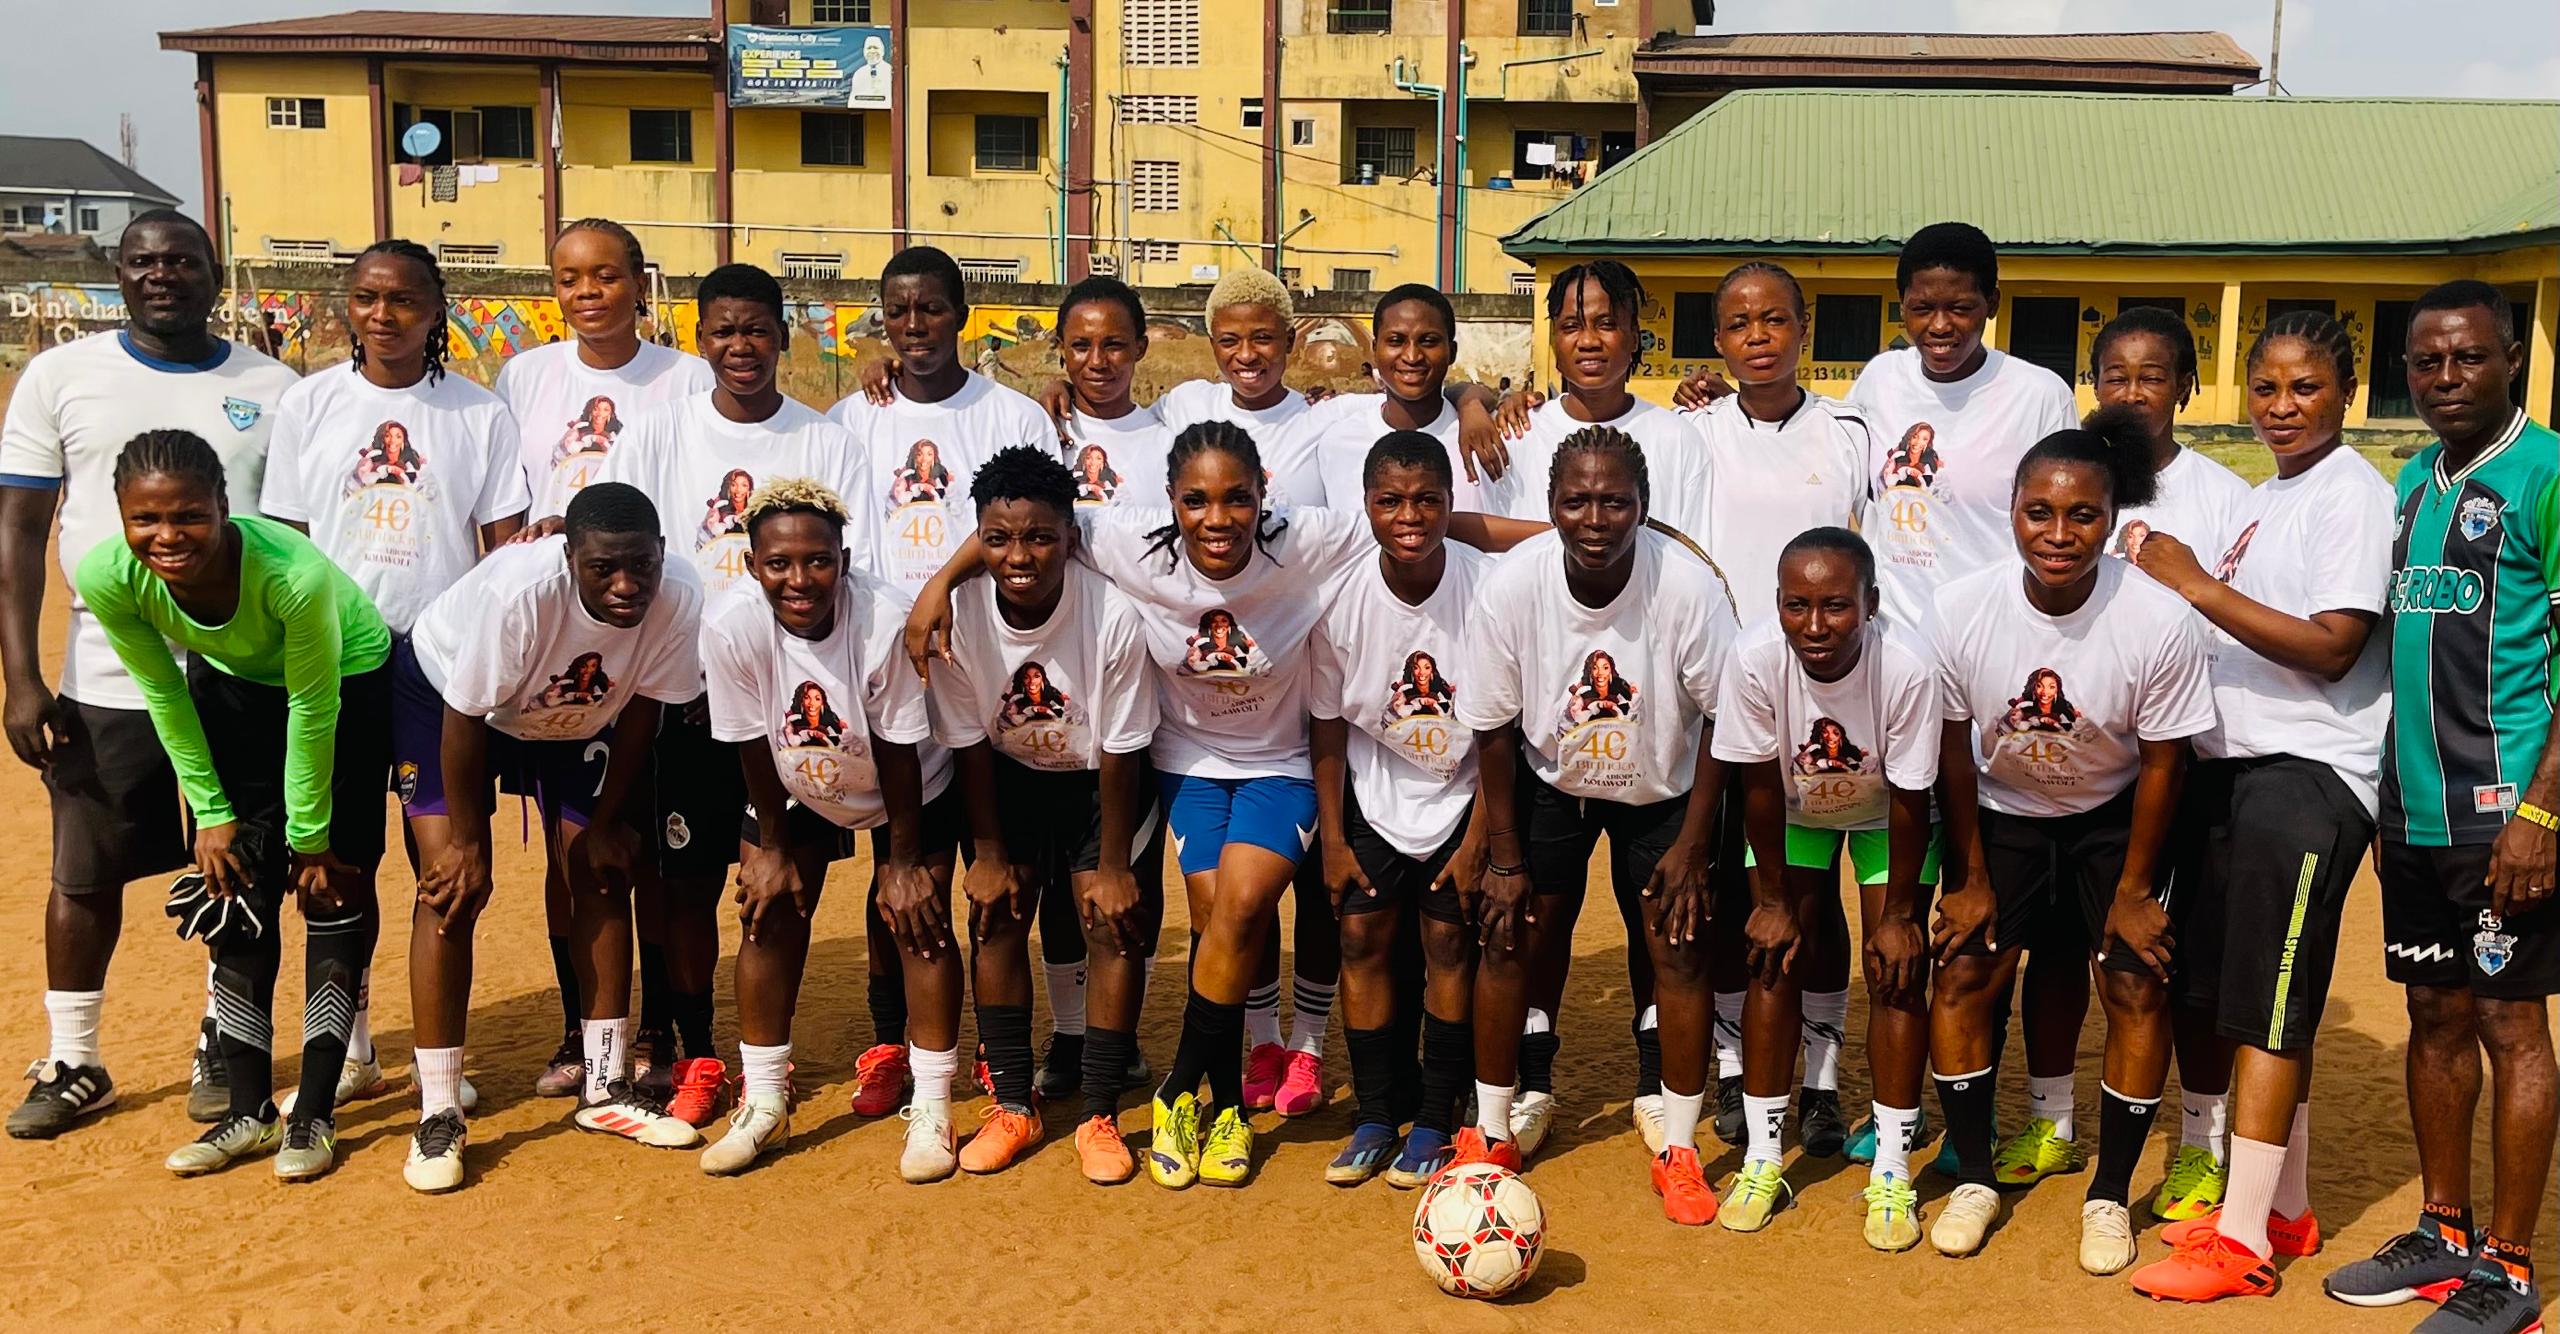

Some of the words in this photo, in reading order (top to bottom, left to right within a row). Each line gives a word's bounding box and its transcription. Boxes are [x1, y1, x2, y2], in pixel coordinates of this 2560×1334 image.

[742, 50, 801, 59] EXPERIENCE
[1658, 306, 1666, 319] A
[1658, 337, 1665, 351] B
[1656, 364, 1664, 377] 3
[1669, 364, 1680, 377] 4
[1814, 367, 1828, 381] 13
[1831, 367, 1847, 381] 14
[2279, 938, 2298, 972] SPORT
